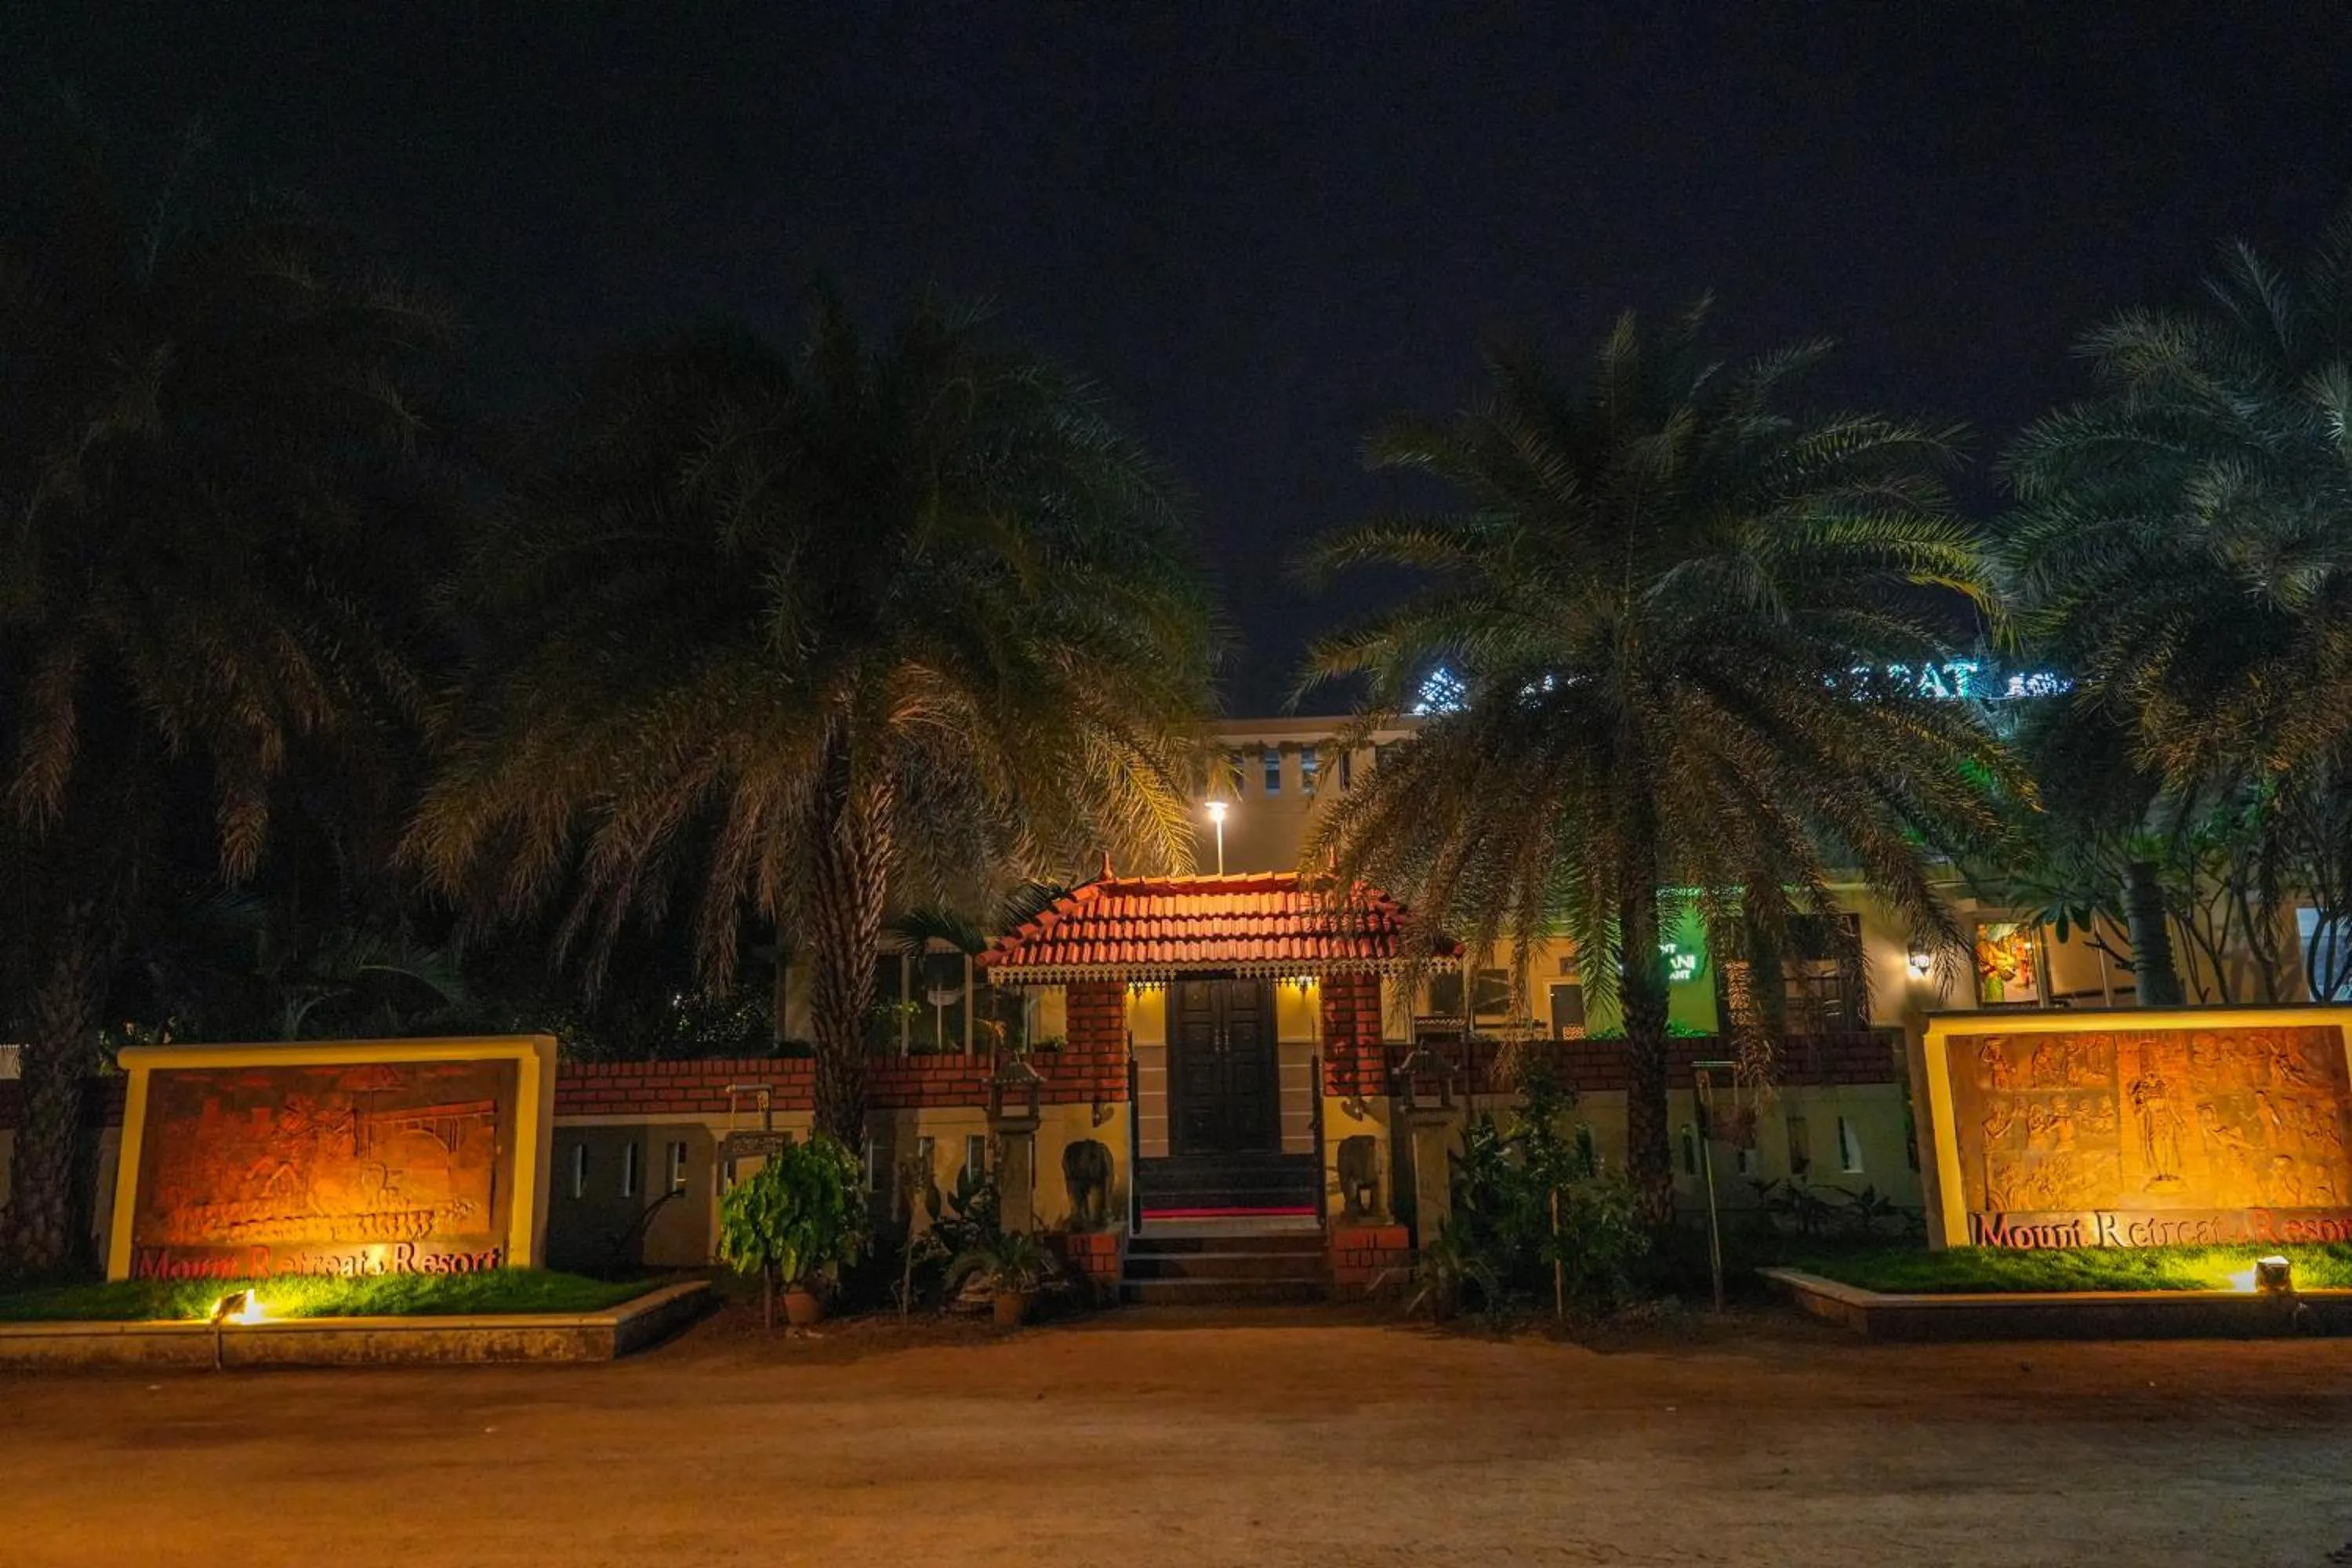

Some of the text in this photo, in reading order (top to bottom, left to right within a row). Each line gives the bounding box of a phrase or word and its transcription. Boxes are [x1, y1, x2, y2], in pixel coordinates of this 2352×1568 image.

[1973, 1211, 2085, 1248] Mount
[2093, 1210, 2221, 1247] Retreat
[140, 1250, 238, 1279] Mount
[249, 1244, 369, 1278] Retreat
[394, 1241, 503, 1275] Resort
